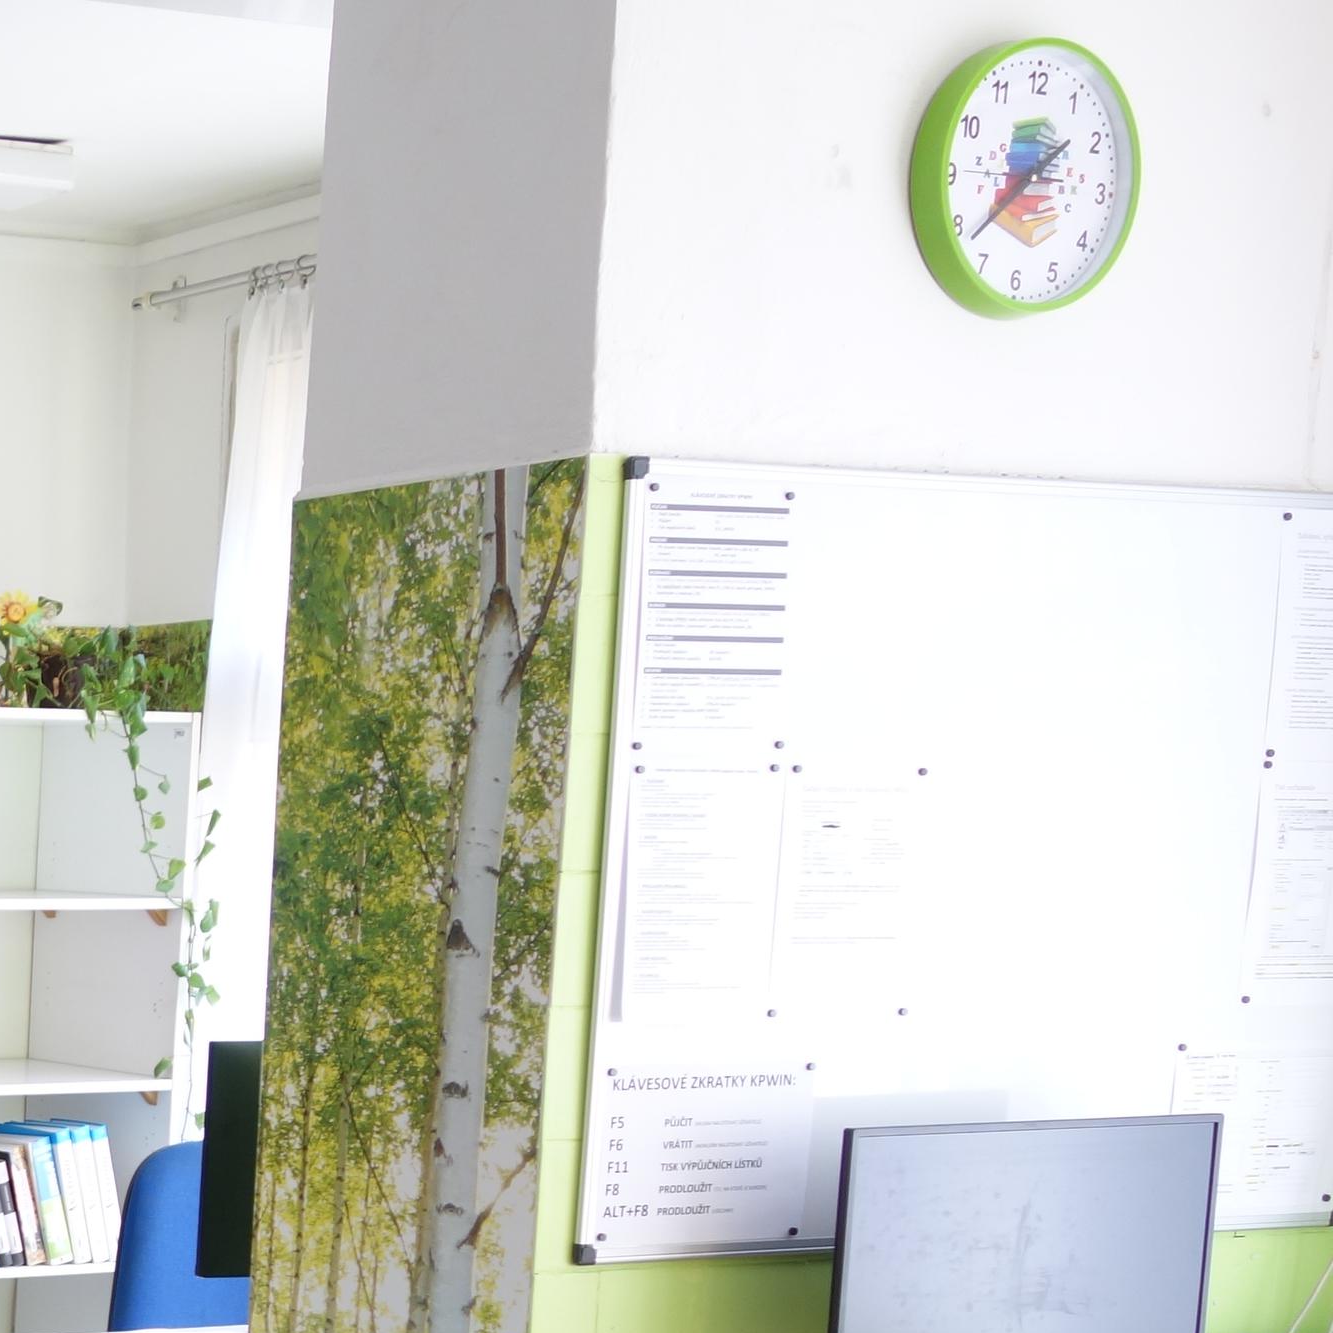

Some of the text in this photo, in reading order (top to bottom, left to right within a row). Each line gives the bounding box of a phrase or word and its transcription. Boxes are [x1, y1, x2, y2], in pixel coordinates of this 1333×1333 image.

[992, 80, 1009, 104] 11
[1029, 71, 1049, 96] 12
[1069, 92, 1078, 114] 1
[961, 115, 980, 139] 10
[1089, 131, 1102, 154] 2
[947, 162, 957, 186] 9
[1095, 183, 1106, 205] 3
[1077, 230, 1088, 251] 4
[978, 253, 989, 274] 7
[1047, 262, 1058, 282] 5
[1010, 270, 1021, 290] 6
[613, 1074, 796, 1091] KLÁVESOVÉ ZKRATKY KPWIN:
[611, 1117, 624, 1128] F5
[609, 1139, 623, 1151] F6
[663, 1139, 693, 1149] VRÁTIT
[607, 1161, 629, 1173] F11
[661, 1163, 678, 1171] TISK
[605, 1184, 620, 1195] F8
[659, 1182, 712, 1194] PRODLOUŽIT
[604, 1205, 649, 1218] ALT+F8
[657, 1206, 710, 1215] PRODLOUŽIT
